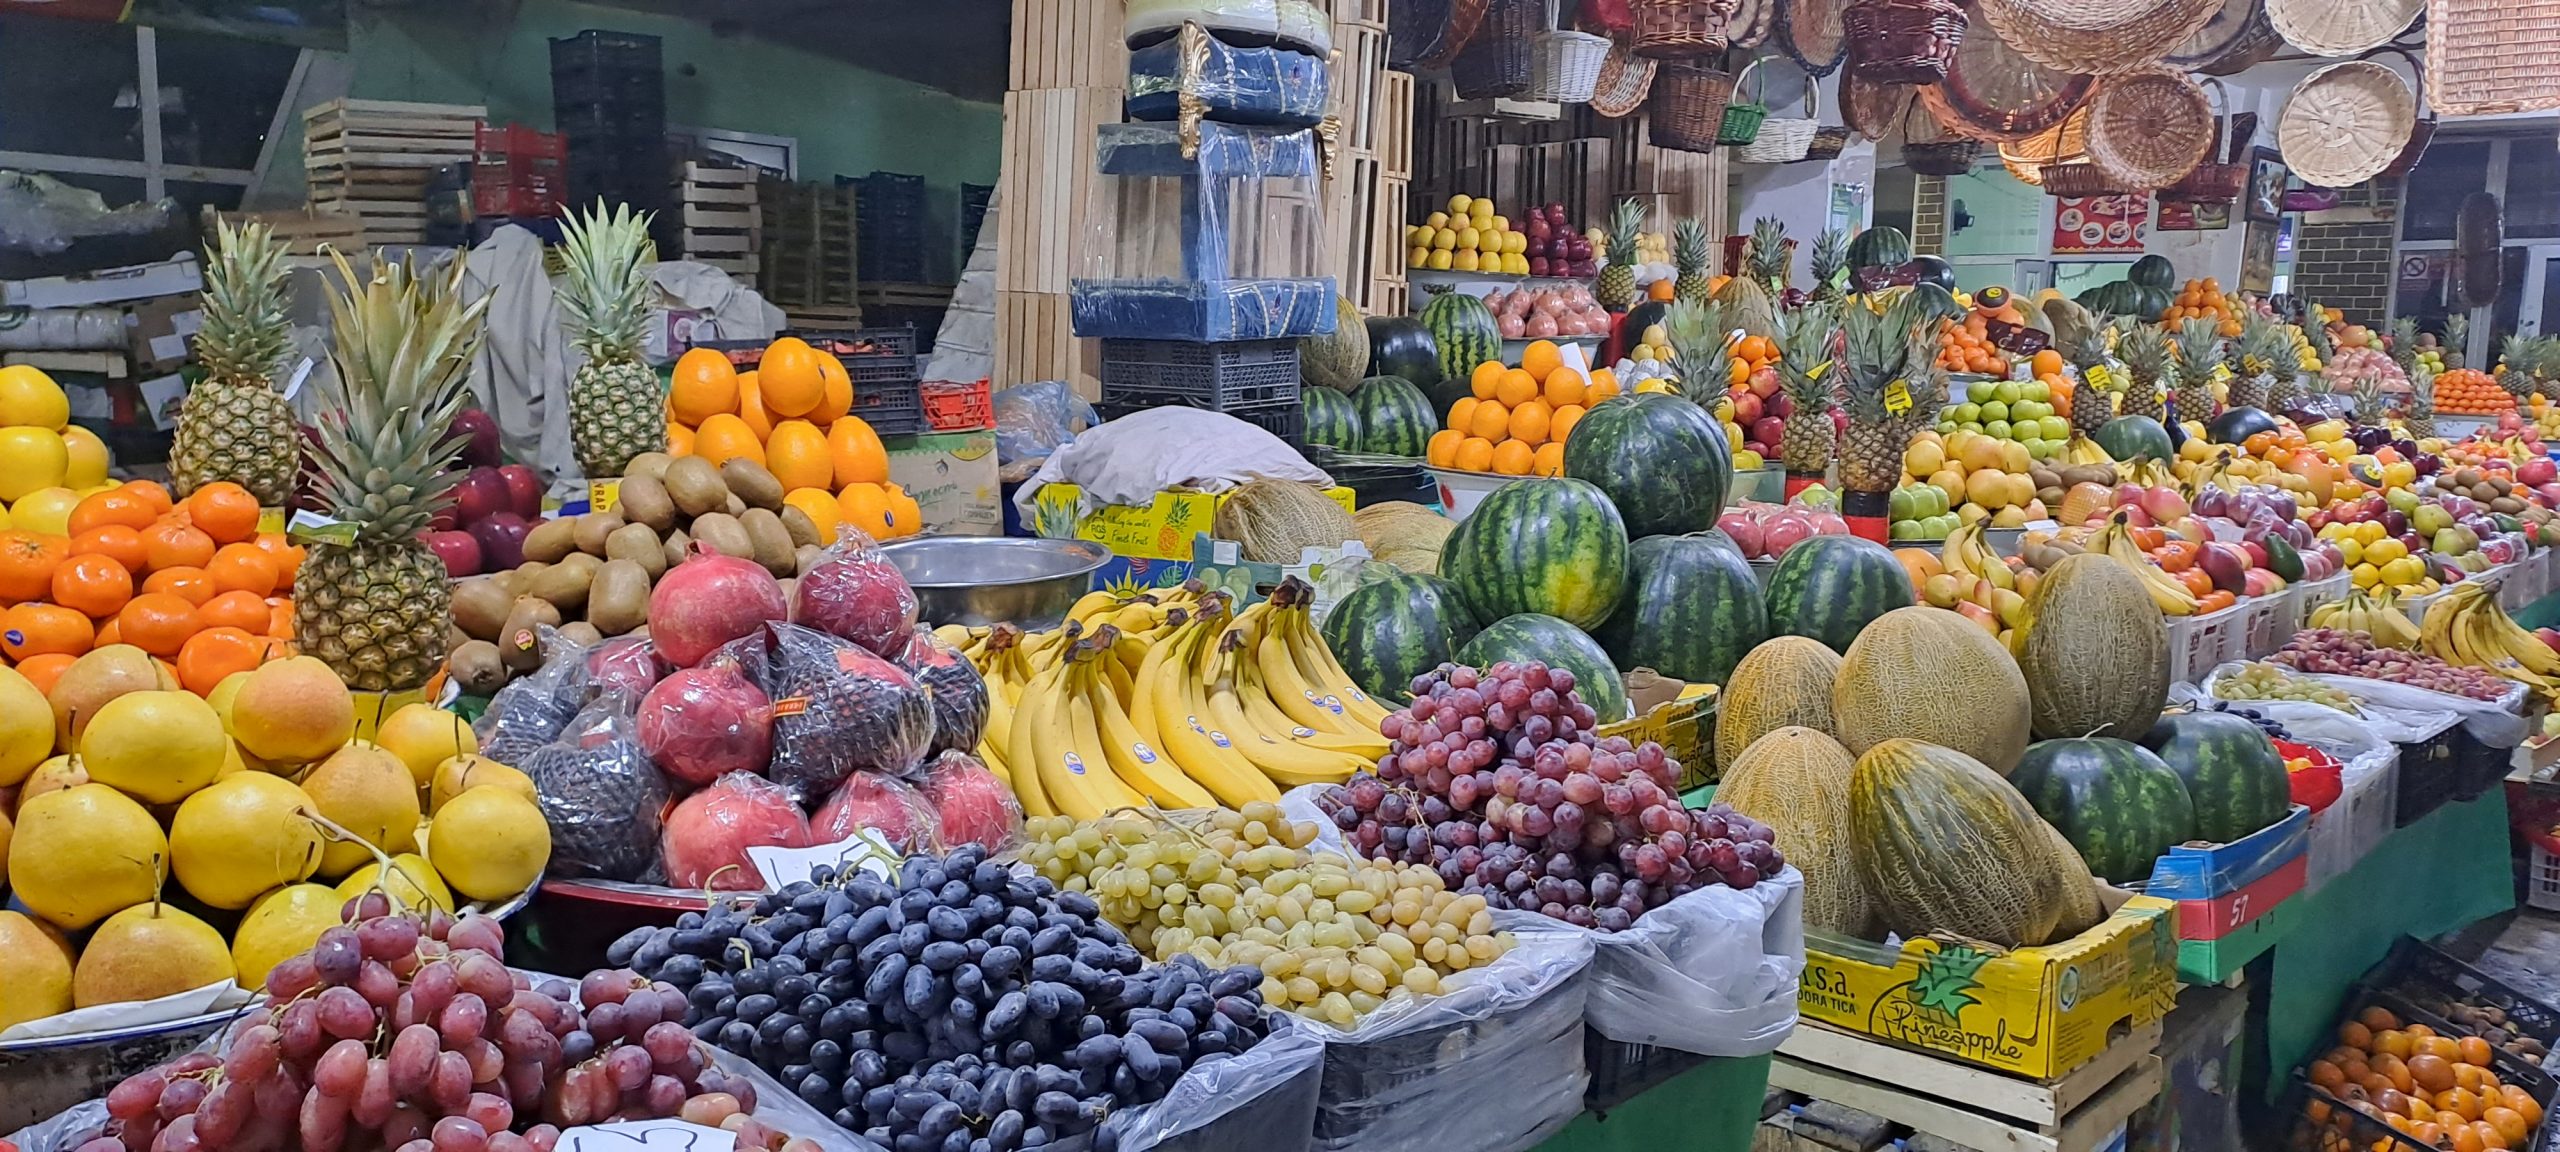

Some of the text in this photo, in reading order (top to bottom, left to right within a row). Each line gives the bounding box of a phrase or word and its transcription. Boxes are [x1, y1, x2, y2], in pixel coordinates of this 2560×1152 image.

[2230, 894, 2249, 927] 57
[1830, 997, 1857, 1015] TICA
[1889, 1000, 2024, 1060] Pineapple
